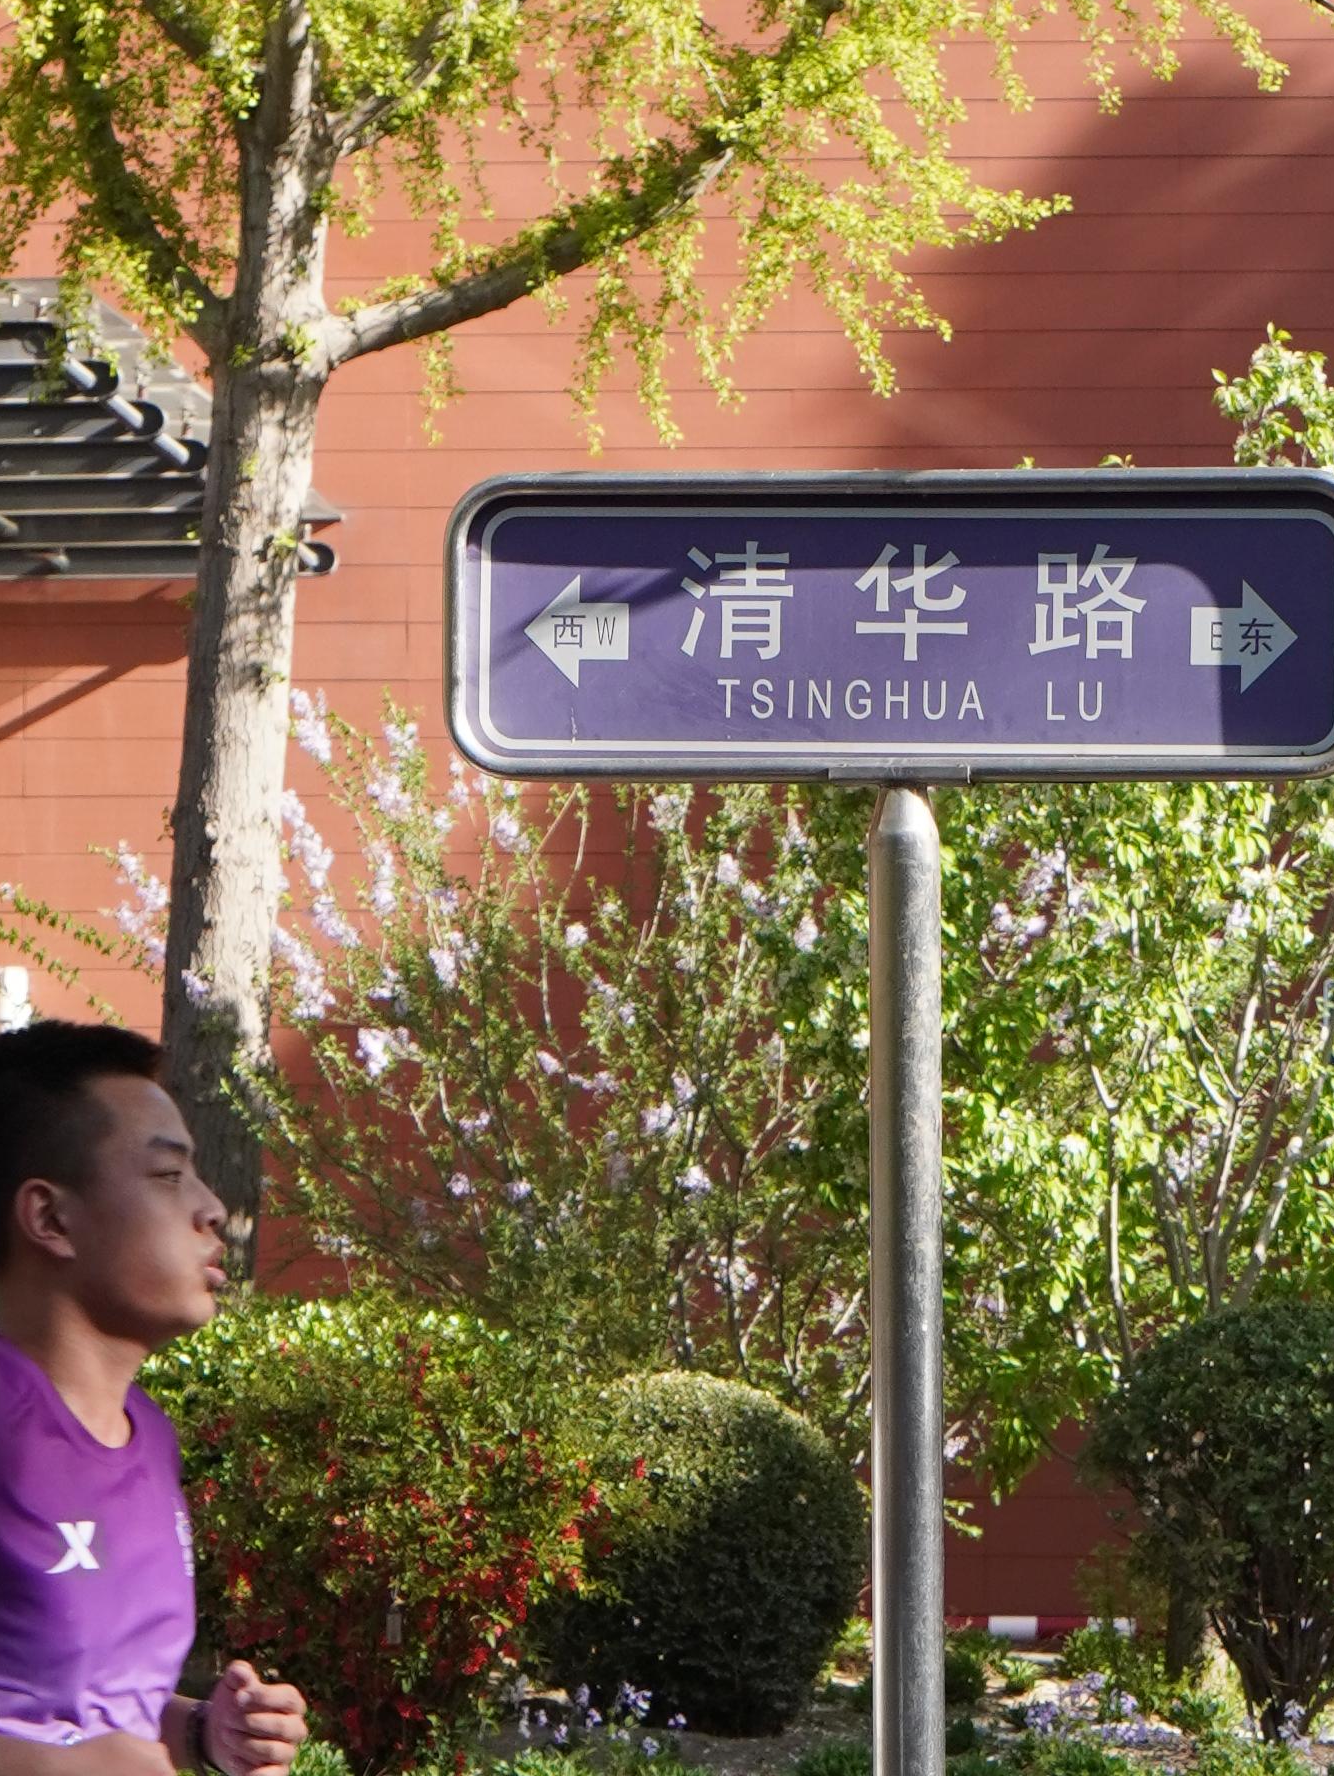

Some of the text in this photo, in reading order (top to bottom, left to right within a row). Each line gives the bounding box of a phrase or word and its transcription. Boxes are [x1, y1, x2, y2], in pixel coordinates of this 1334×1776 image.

[679, 540, 1148, 662] 清华路
[550, 614, 617, 649] 西 W
[1210, 617, 1275, 656] E 东
[717, 678, 1104, 722] TSINGHUA LU
